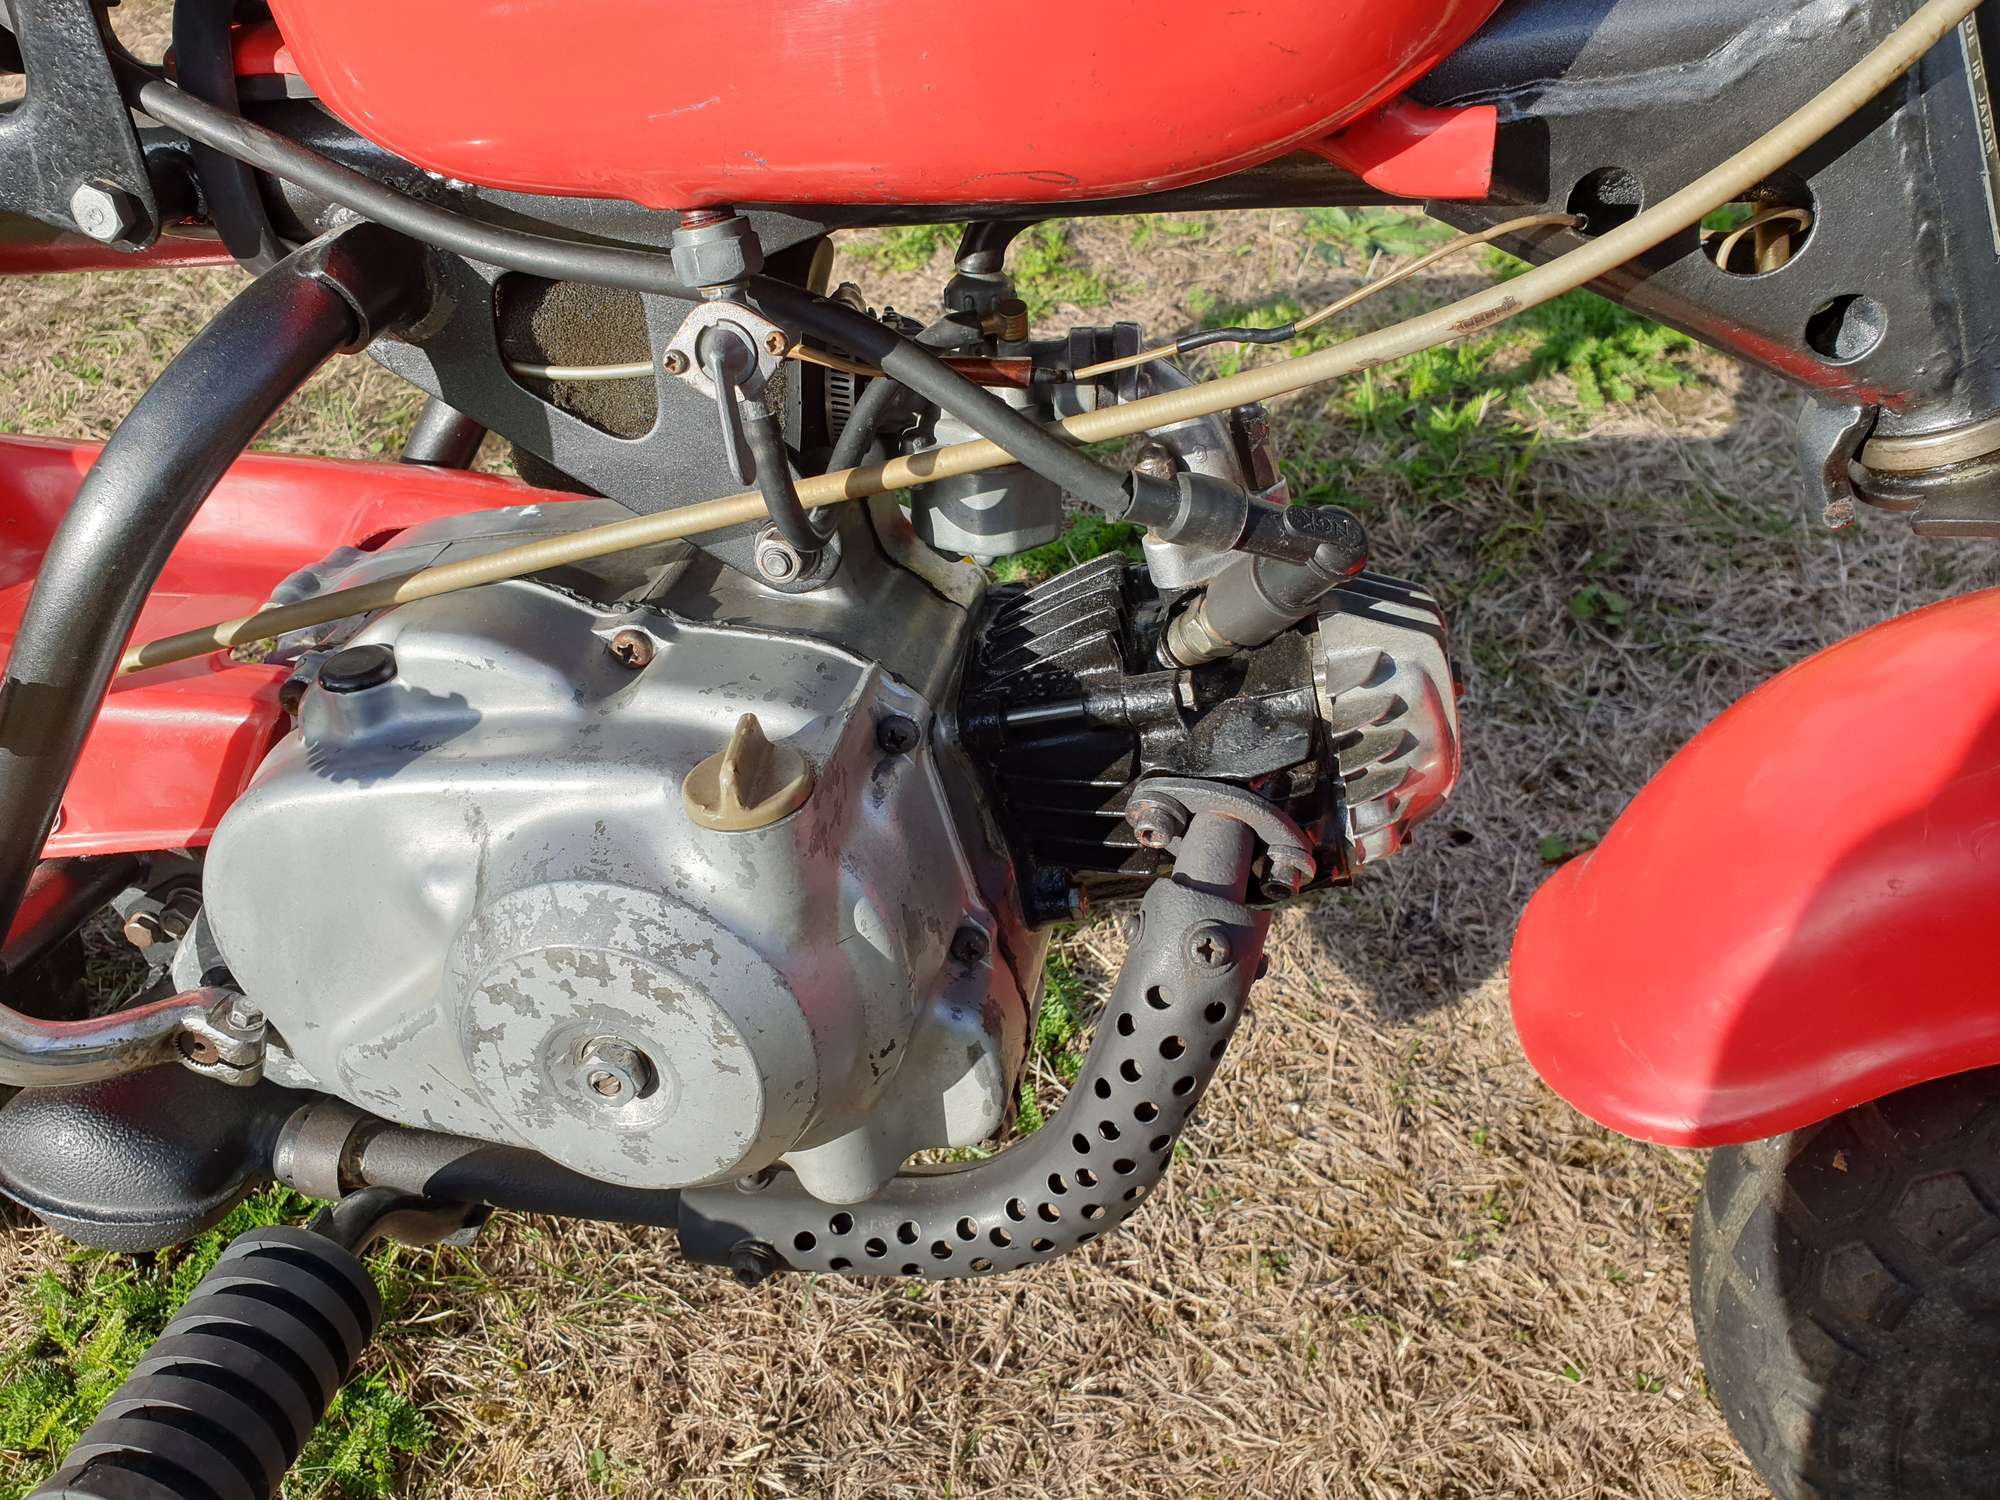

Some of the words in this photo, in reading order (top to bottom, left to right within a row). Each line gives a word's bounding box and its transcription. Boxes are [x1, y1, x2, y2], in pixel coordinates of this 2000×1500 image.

[1964, 15, 1976, 48] DE
[1972, 60, 1982, 80] IN
[1978, 93, 1994, 154] JAPAN
